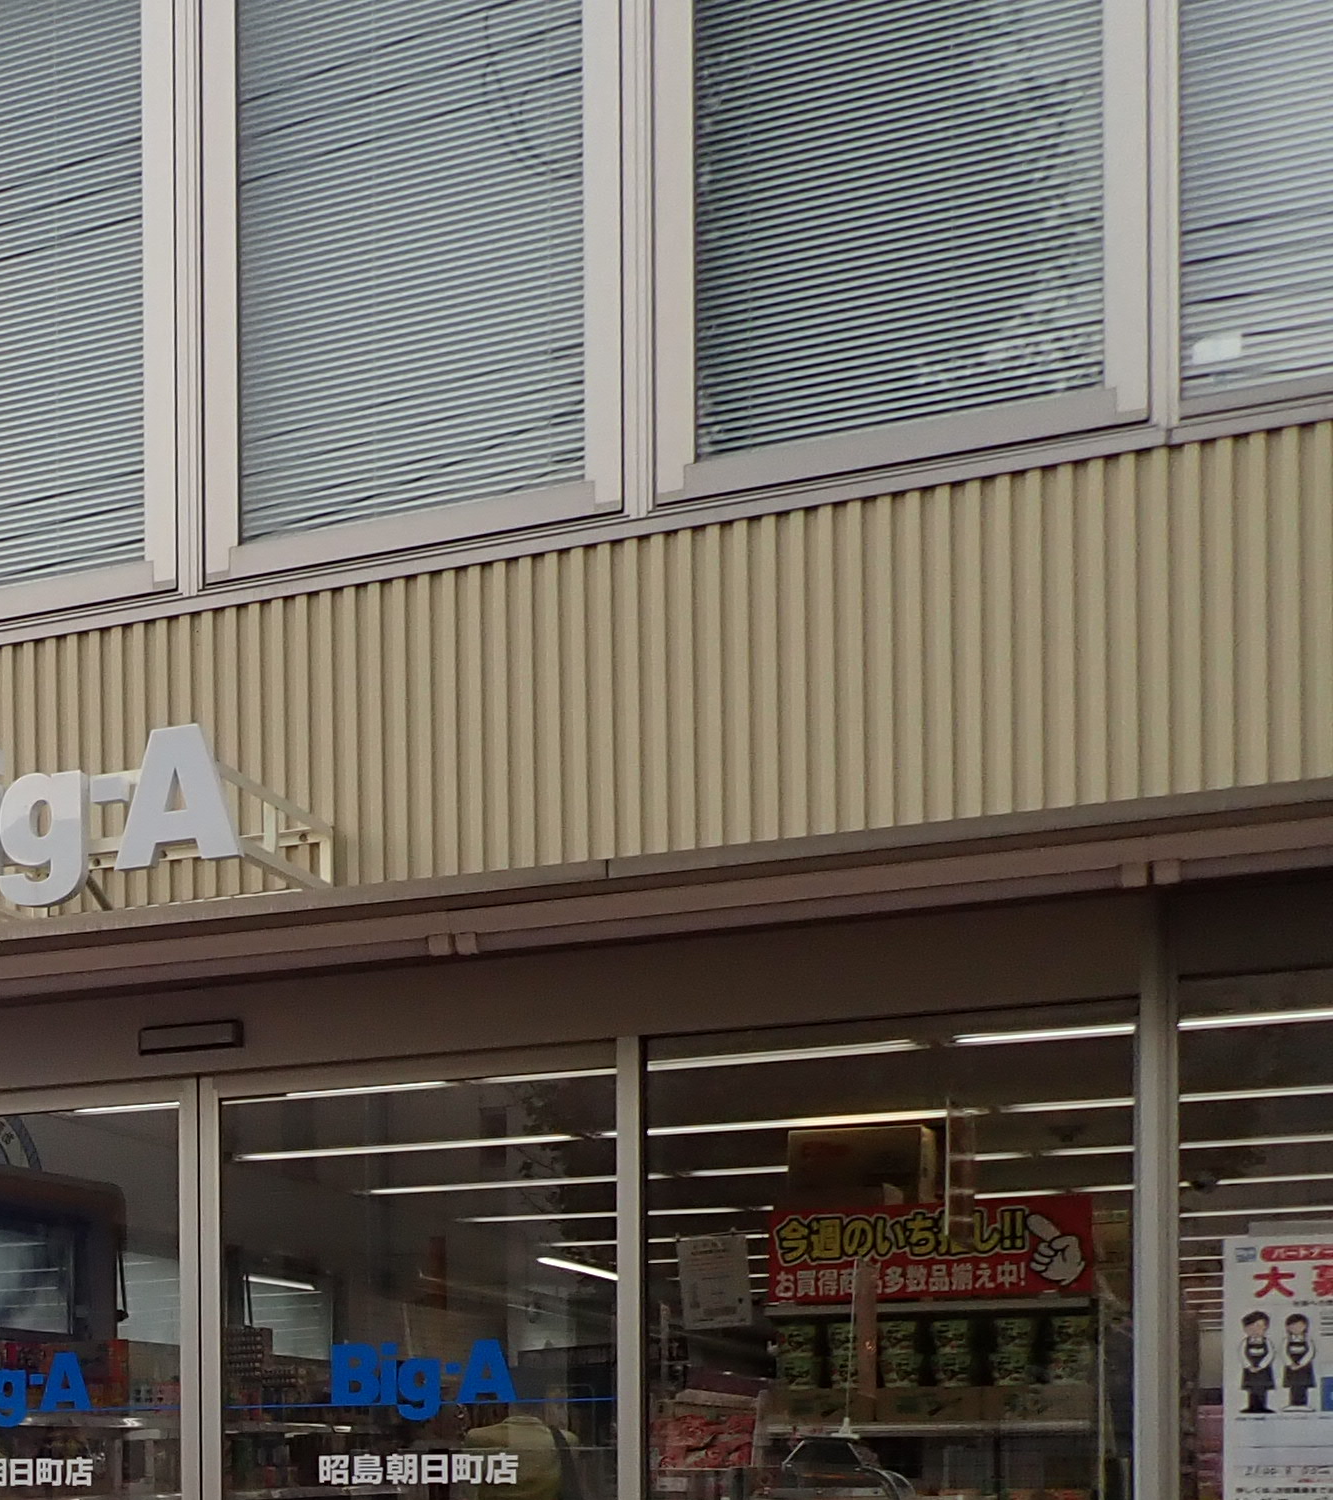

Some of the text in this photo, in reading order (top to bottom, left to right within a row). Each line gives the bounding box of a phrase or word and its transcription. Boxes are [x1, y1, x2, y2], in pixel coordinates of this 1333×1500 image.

[775, 1262, 1026, 1297] お買得商多数品揃え中!
[332, 1339, 518, 1421] Big-A
[318, 1453, 519, 1486] 昭島朝日町店
